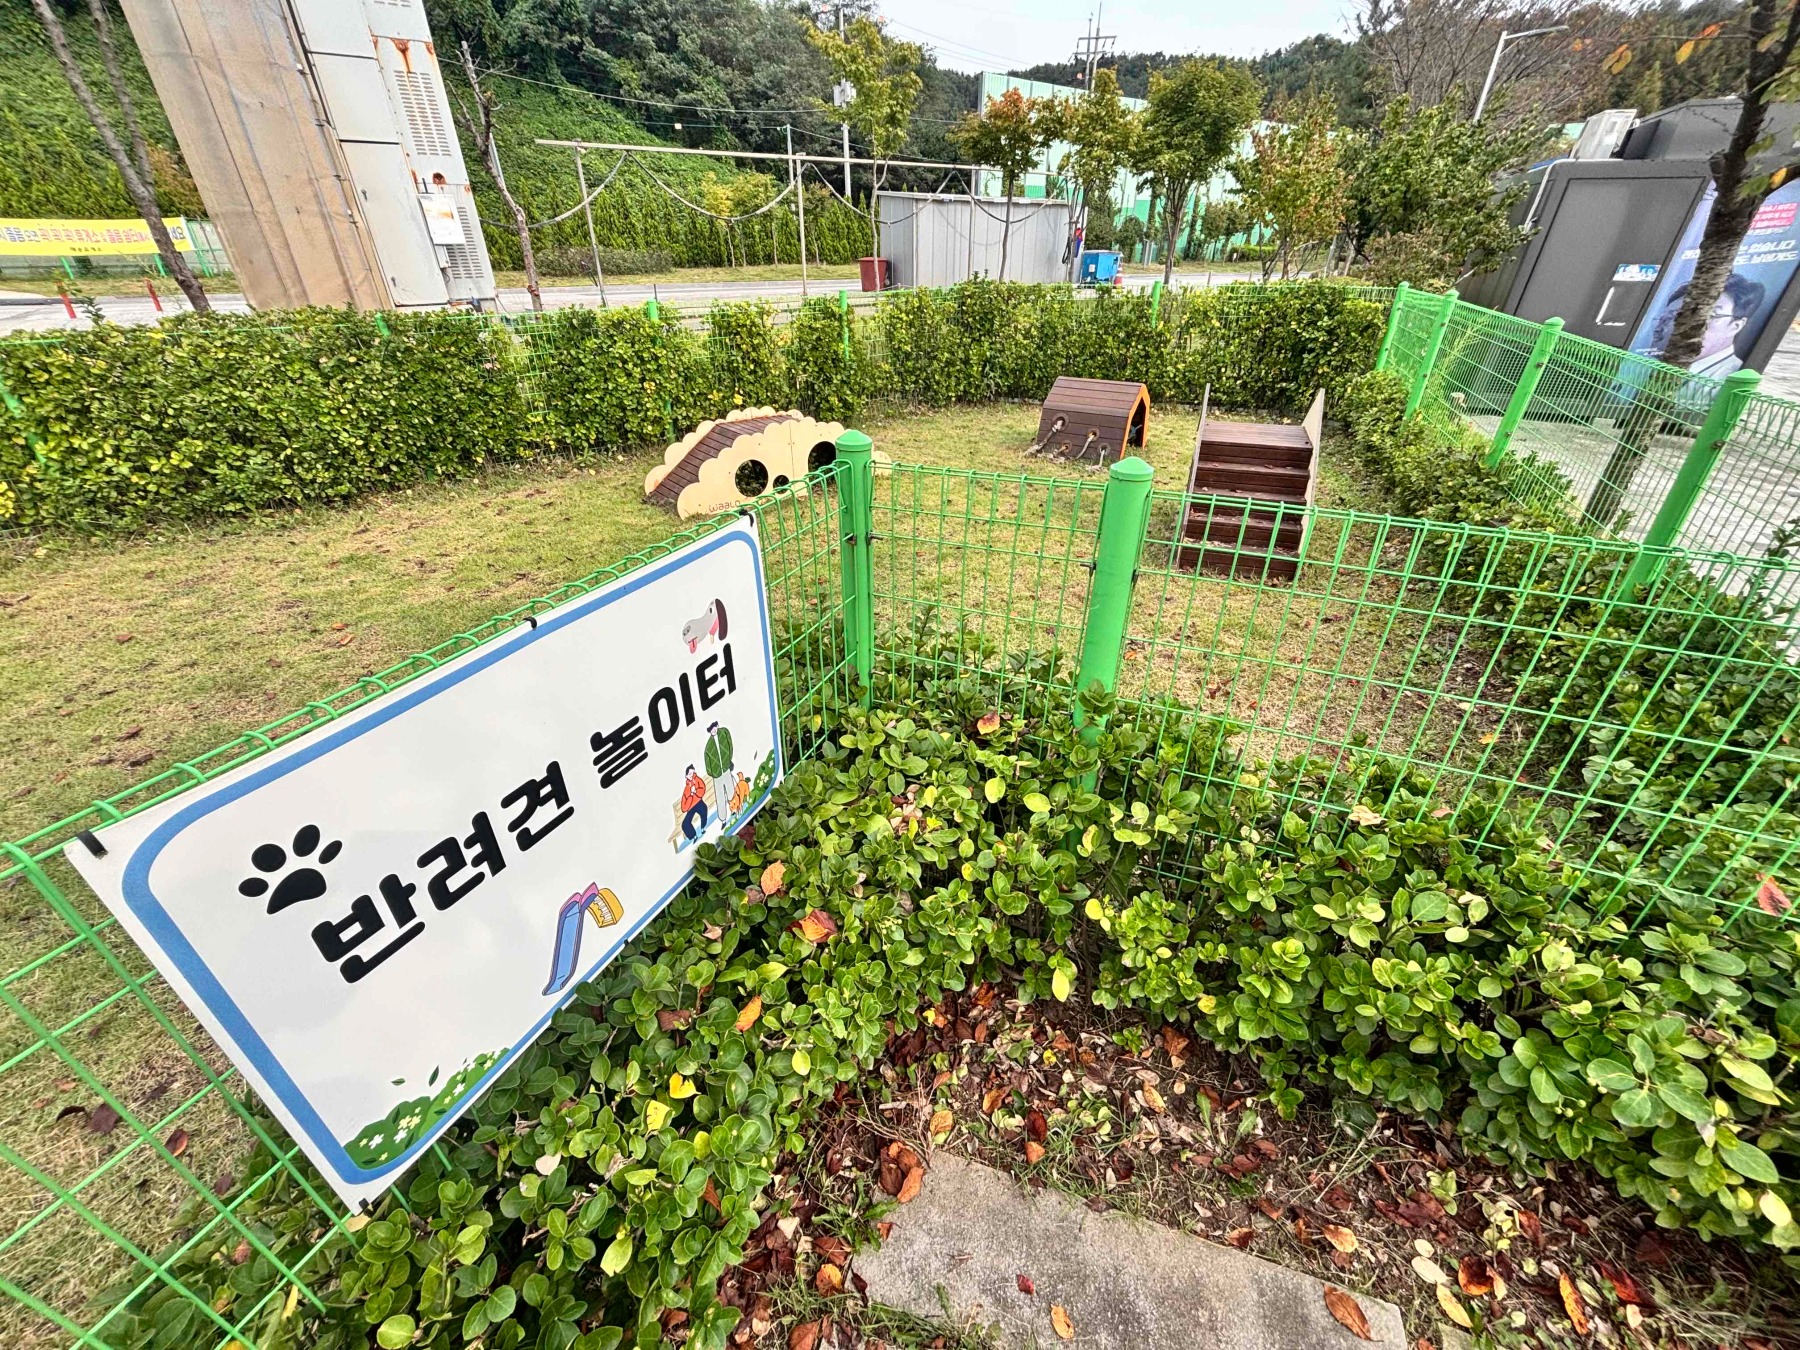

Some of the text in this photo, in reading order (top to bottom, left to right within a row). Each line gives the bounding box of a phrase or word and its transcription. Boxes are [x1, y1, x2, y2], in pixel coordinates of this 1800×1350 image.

[75, 229, 101, 243] 휴게소
[311, 643, 736, 984] 반려견 놀이터
